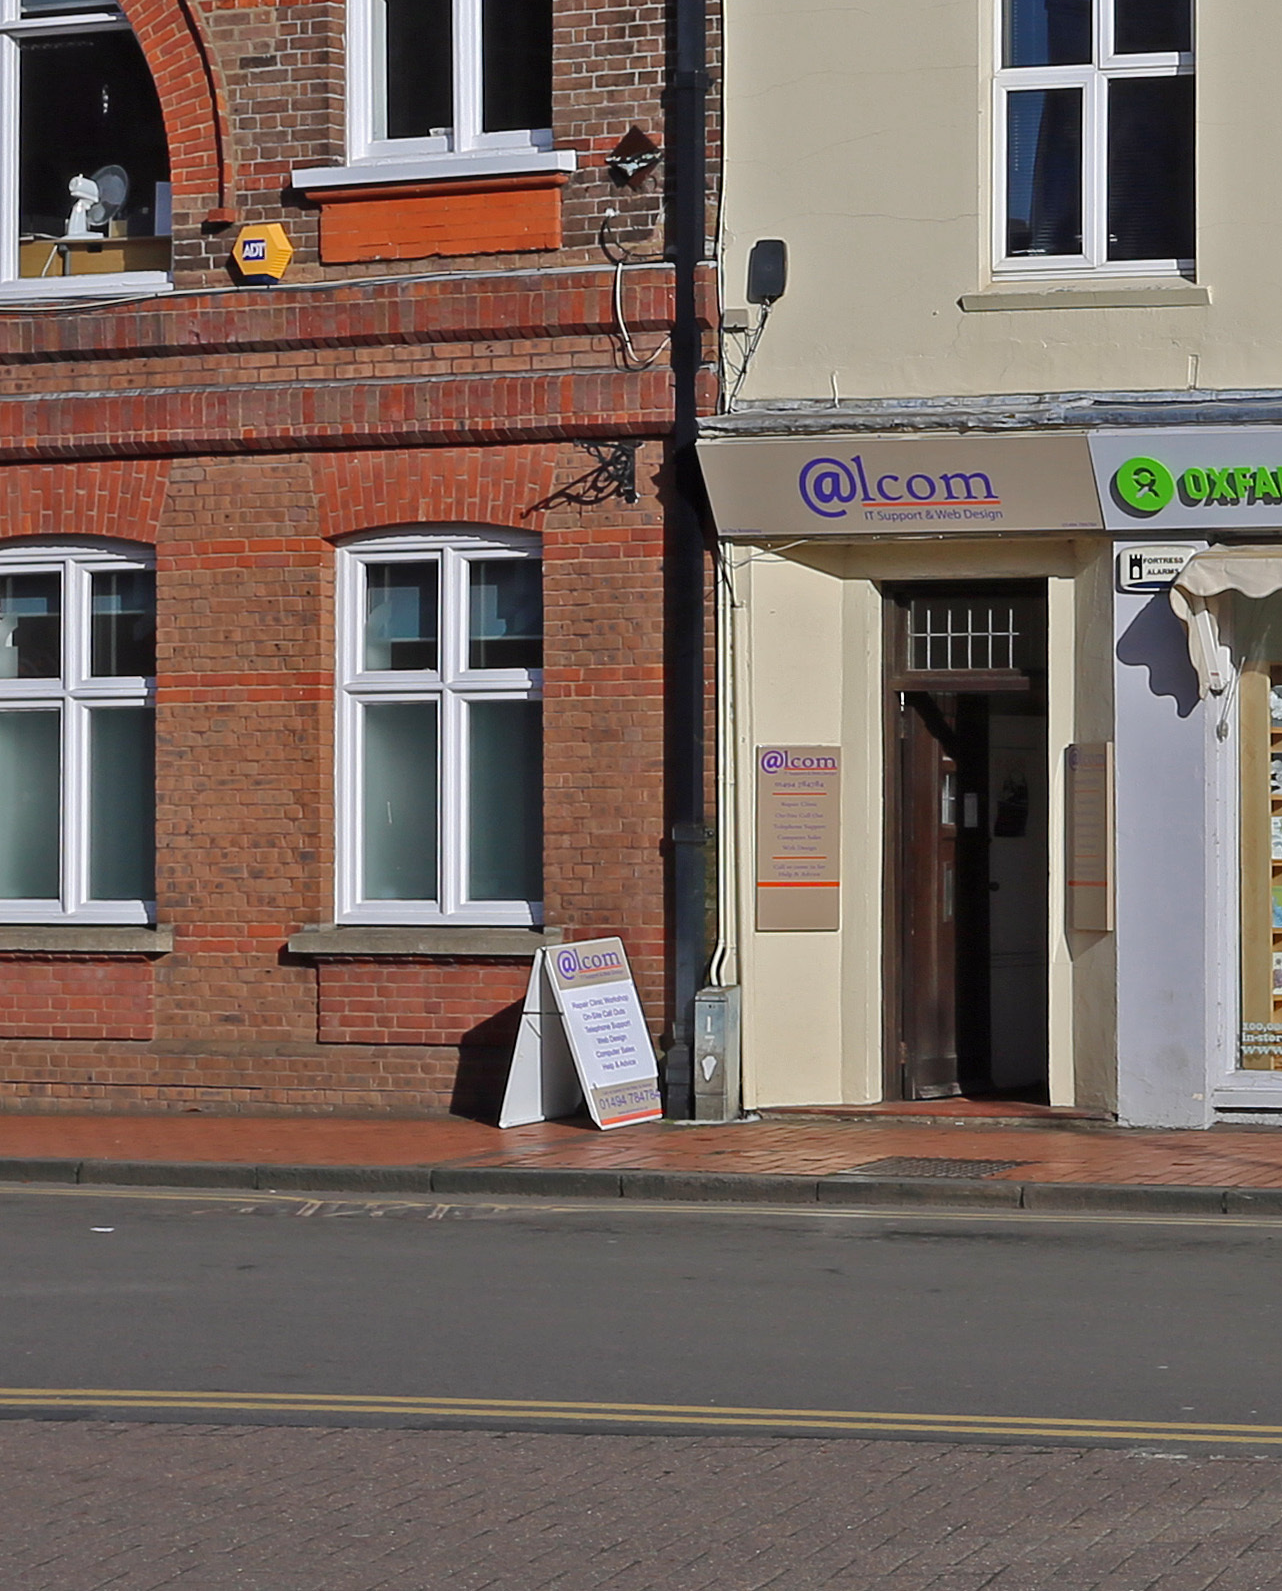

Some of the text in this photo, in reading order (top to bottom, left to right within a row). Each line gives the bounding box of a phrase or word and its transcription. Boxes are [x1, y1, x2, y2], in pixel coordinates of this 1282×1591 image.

[242, 242, 266, 258] ADT
[799, 455, 1000, 518] @lcom
[864, 509, 1004, 523] IT Support & Web Design
[1143, 557, 1184, 565] FORTRESS
[1146, 568, 1180, 576] ALARMS
[761, 750, 837, 775] @lcom
[557, 948, 621, 980] @lcom
[599, 1095, 627, 1110] 01494
